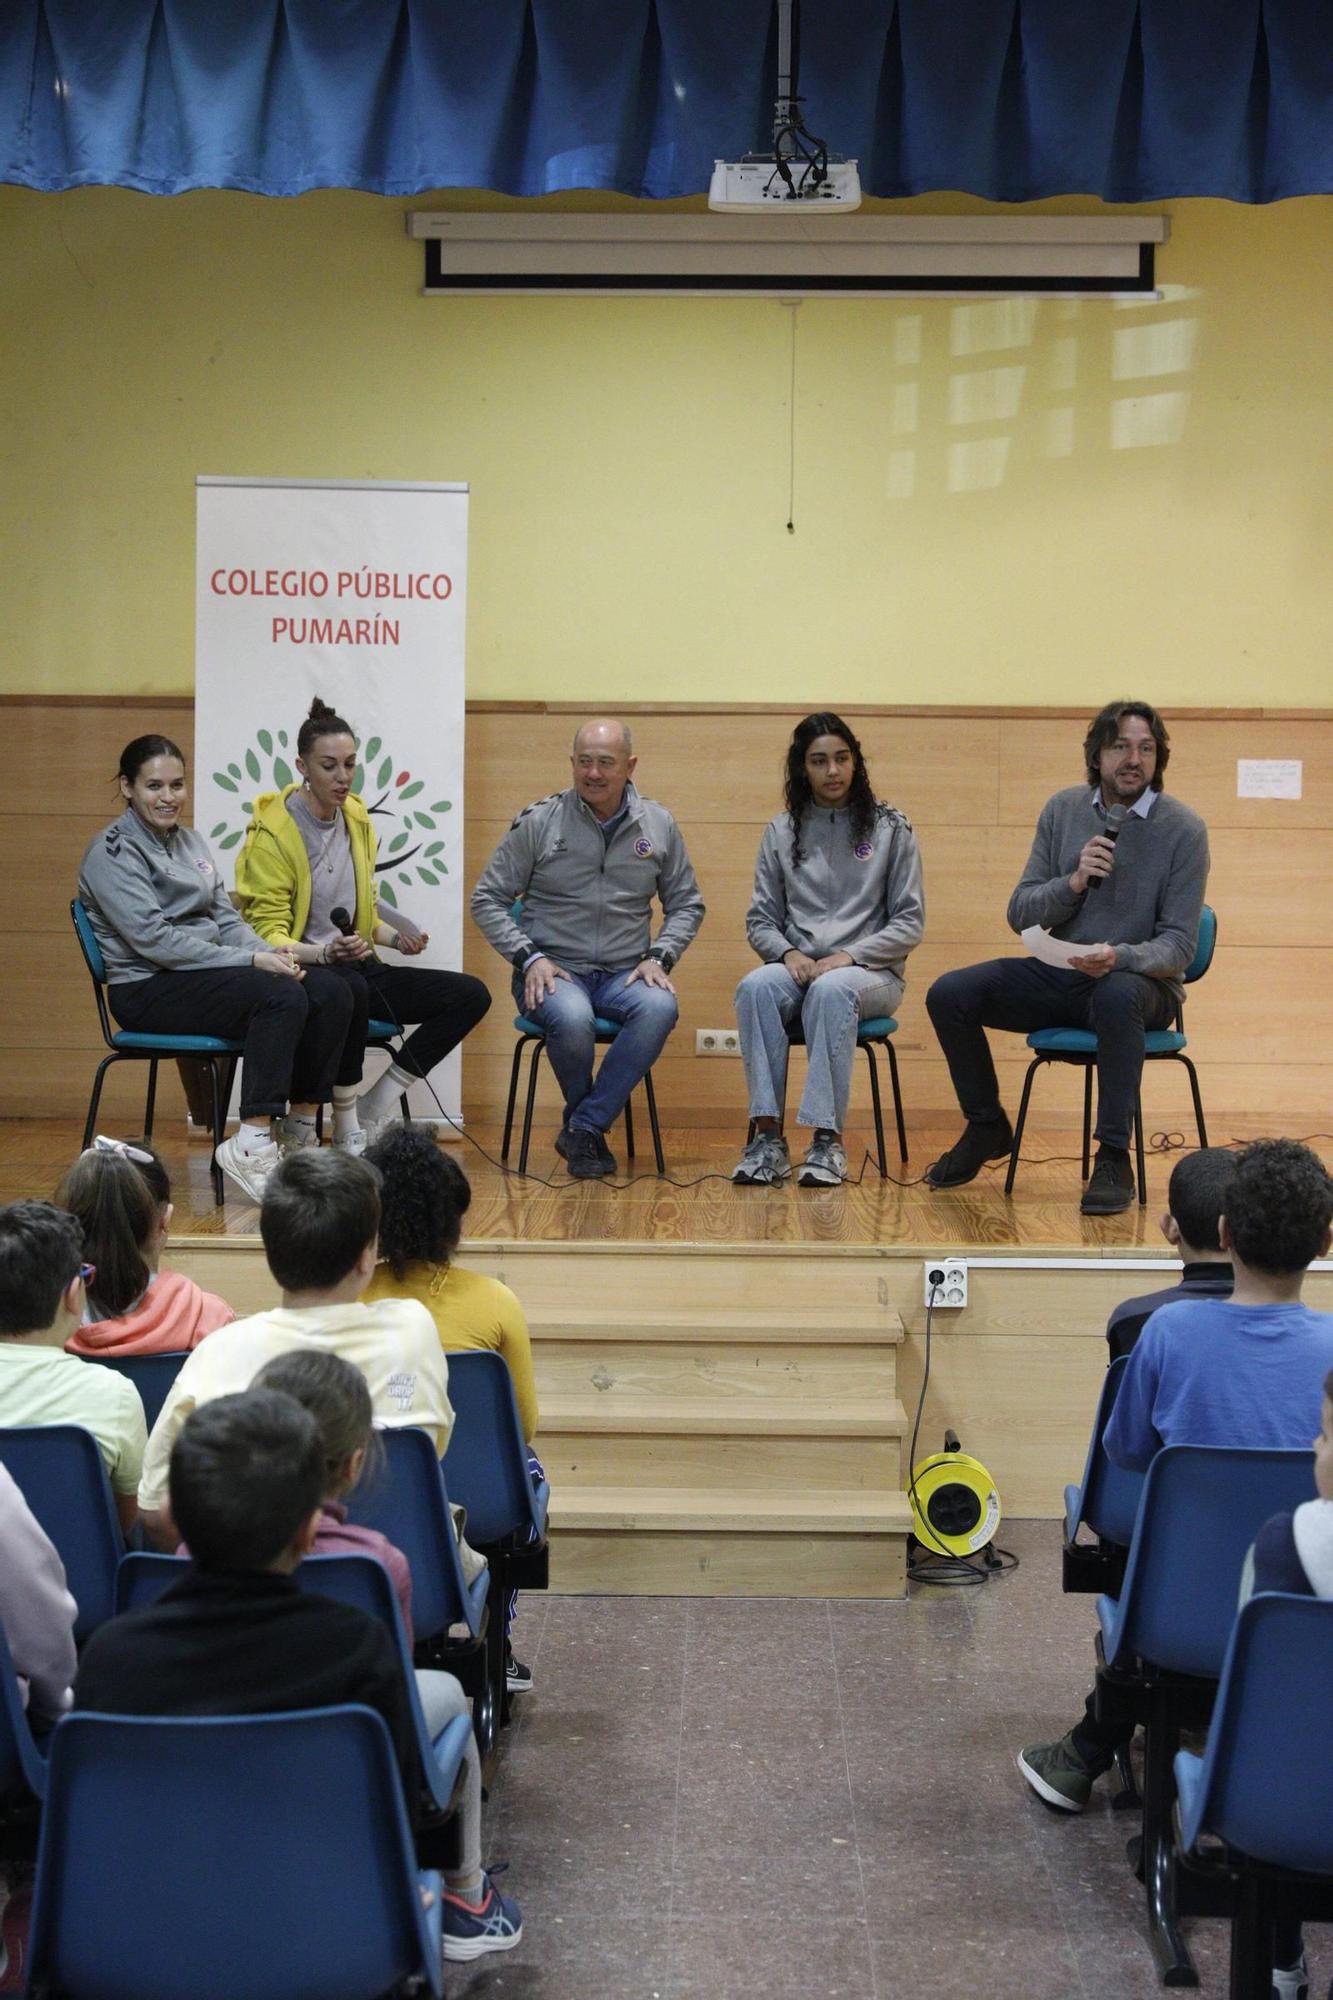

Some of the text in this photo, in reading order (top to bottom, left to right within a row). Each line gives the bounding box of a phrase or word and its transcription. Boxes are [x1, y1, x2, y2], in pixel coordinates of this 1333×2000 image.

[211, 565, 452, 600] COLEGIO PÚBLICO
[272, 612, 400, 645] PUMARÍN
